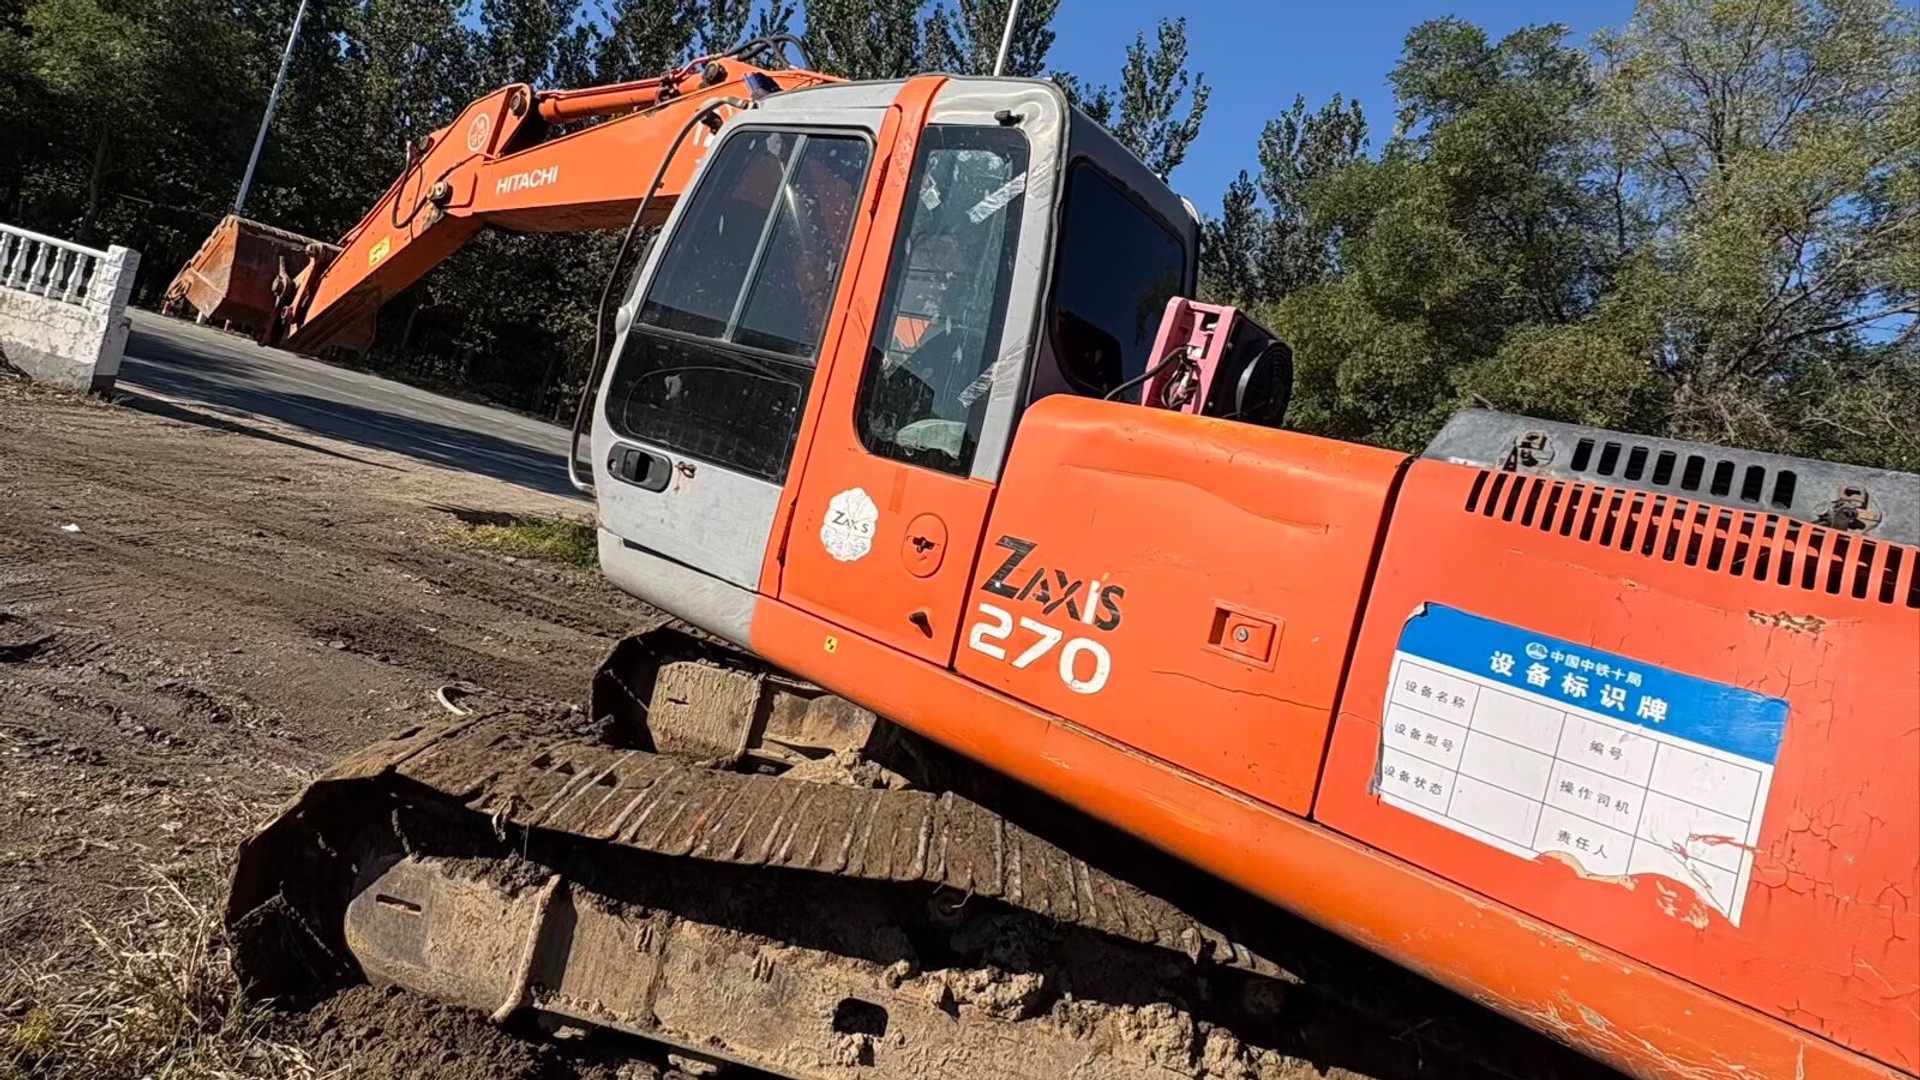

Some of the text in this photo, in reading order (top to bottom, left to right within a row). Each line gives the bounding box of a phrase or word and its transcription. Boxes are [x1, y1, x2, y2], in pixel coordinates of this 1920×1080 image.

[497, 165, 558, 195] HITACHI
[832, 510, 869, 533] ZAXS
[981, 535, 1125, 631] ZAXIS
[968, 603, 1112, 695] 270
[1550, 650, 1643, 687] 中国中铁十局
[1405, 680, 1466, 709] 设备名称
[1490, 651, 1669, 723] 设备标识牌
[1394, 722, 1454, 753] 设备型号
[1589, 740, 1623, 761] 编号
[1384, 764, 1443, 796] 设备状态
[1559, 780, 1630, 815] 操作司机
[1556, 830, 1608, 859] 责任人
